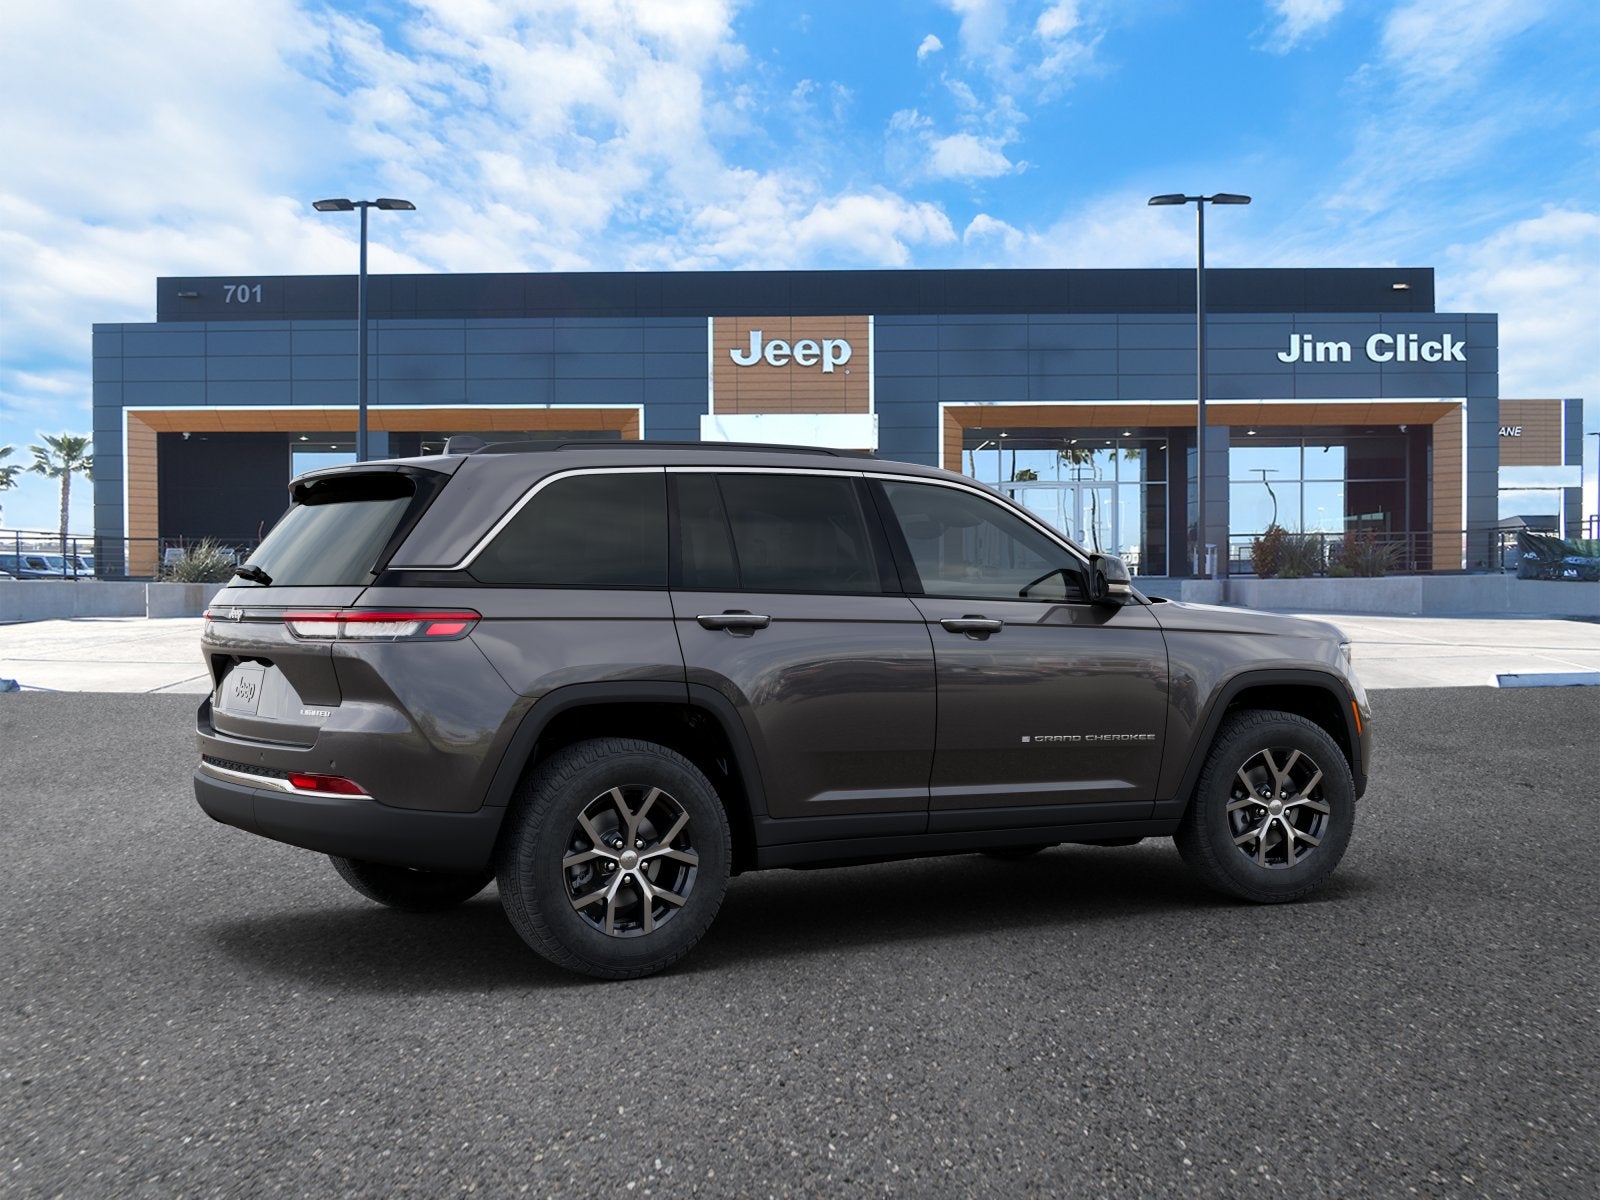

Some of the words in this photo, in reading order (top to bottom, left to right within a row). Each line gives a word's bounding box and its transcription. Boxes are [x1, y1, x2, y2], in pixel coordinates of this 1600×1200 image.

[223, 284, 262, 304] 701
[729, 330, 852, 374] Jeep
[1277, 333, 1352, 363] Jim
[1365, 332, 1467, 363] Click
[1085, 733, 1156, 741] CHEROKEE
